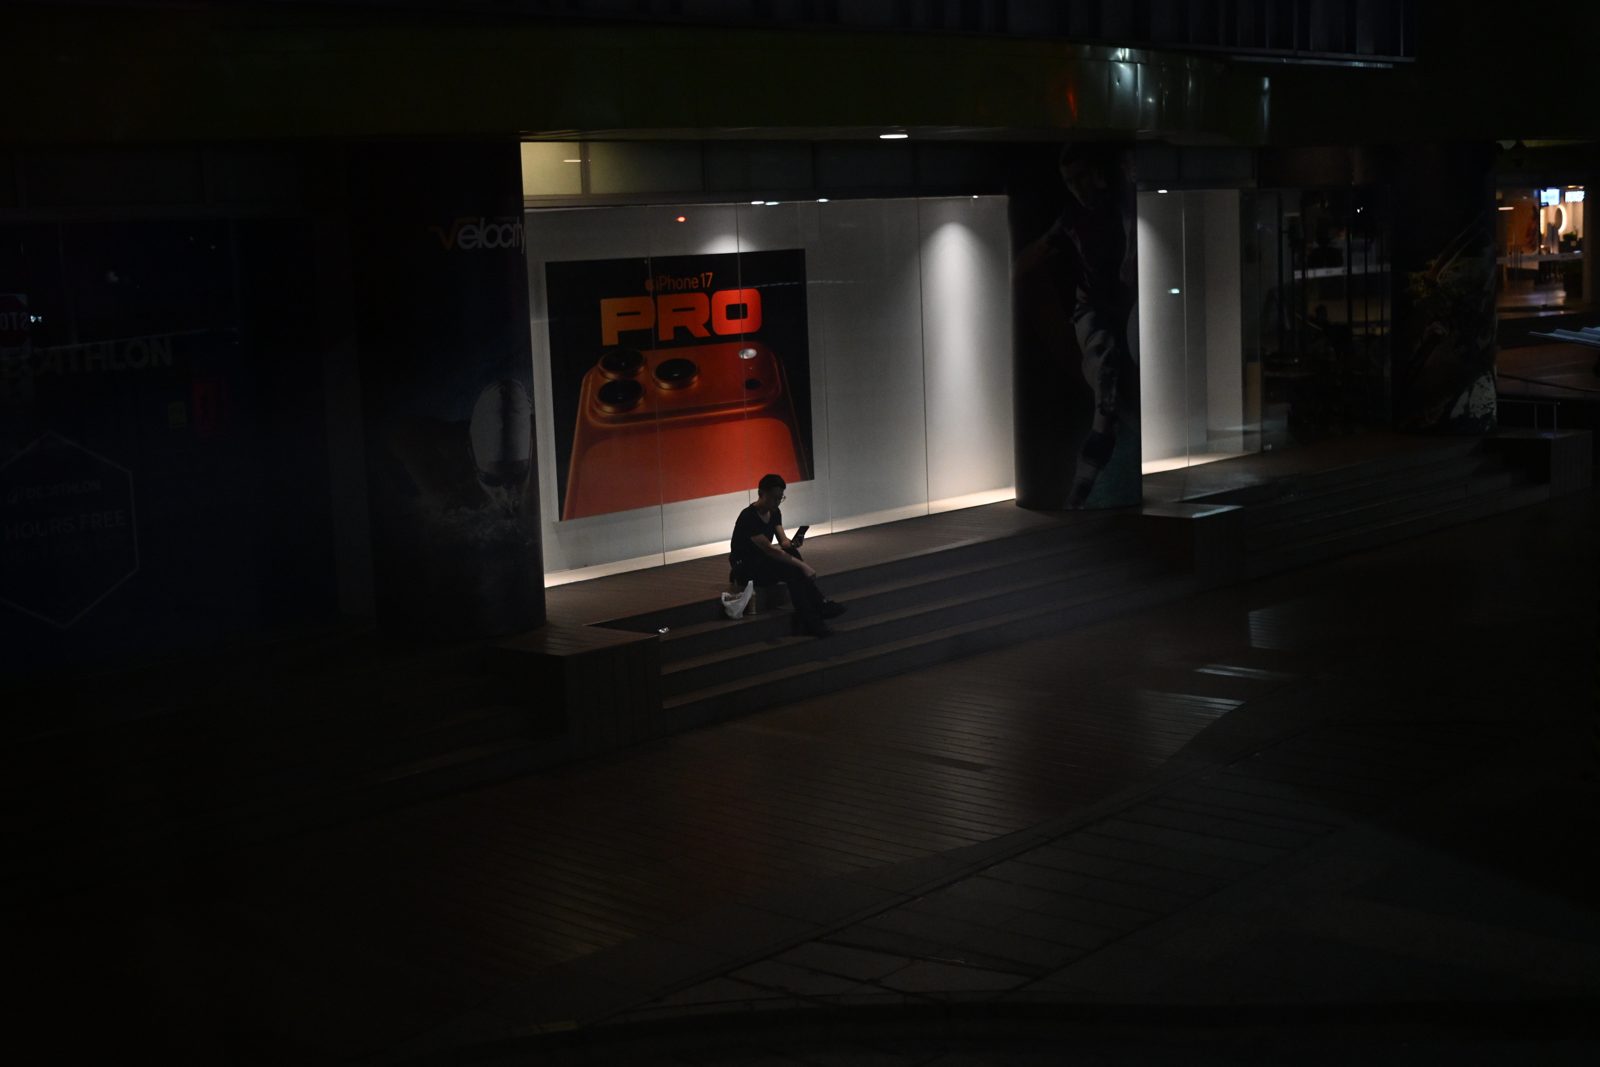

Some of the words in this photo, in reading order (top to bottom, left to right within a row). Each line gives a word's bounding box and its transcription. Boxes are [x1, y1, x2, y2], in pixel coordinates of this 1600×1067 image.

[428, 215, 525, 254] Velocity
[655, 274, 699, 291] iPhone
[699, 271, 714, 289] 17
[600, 287, 763, 347] PRO
[4, 515, 77, 541] HOURS
[79, 509, 129, 532] FREE
